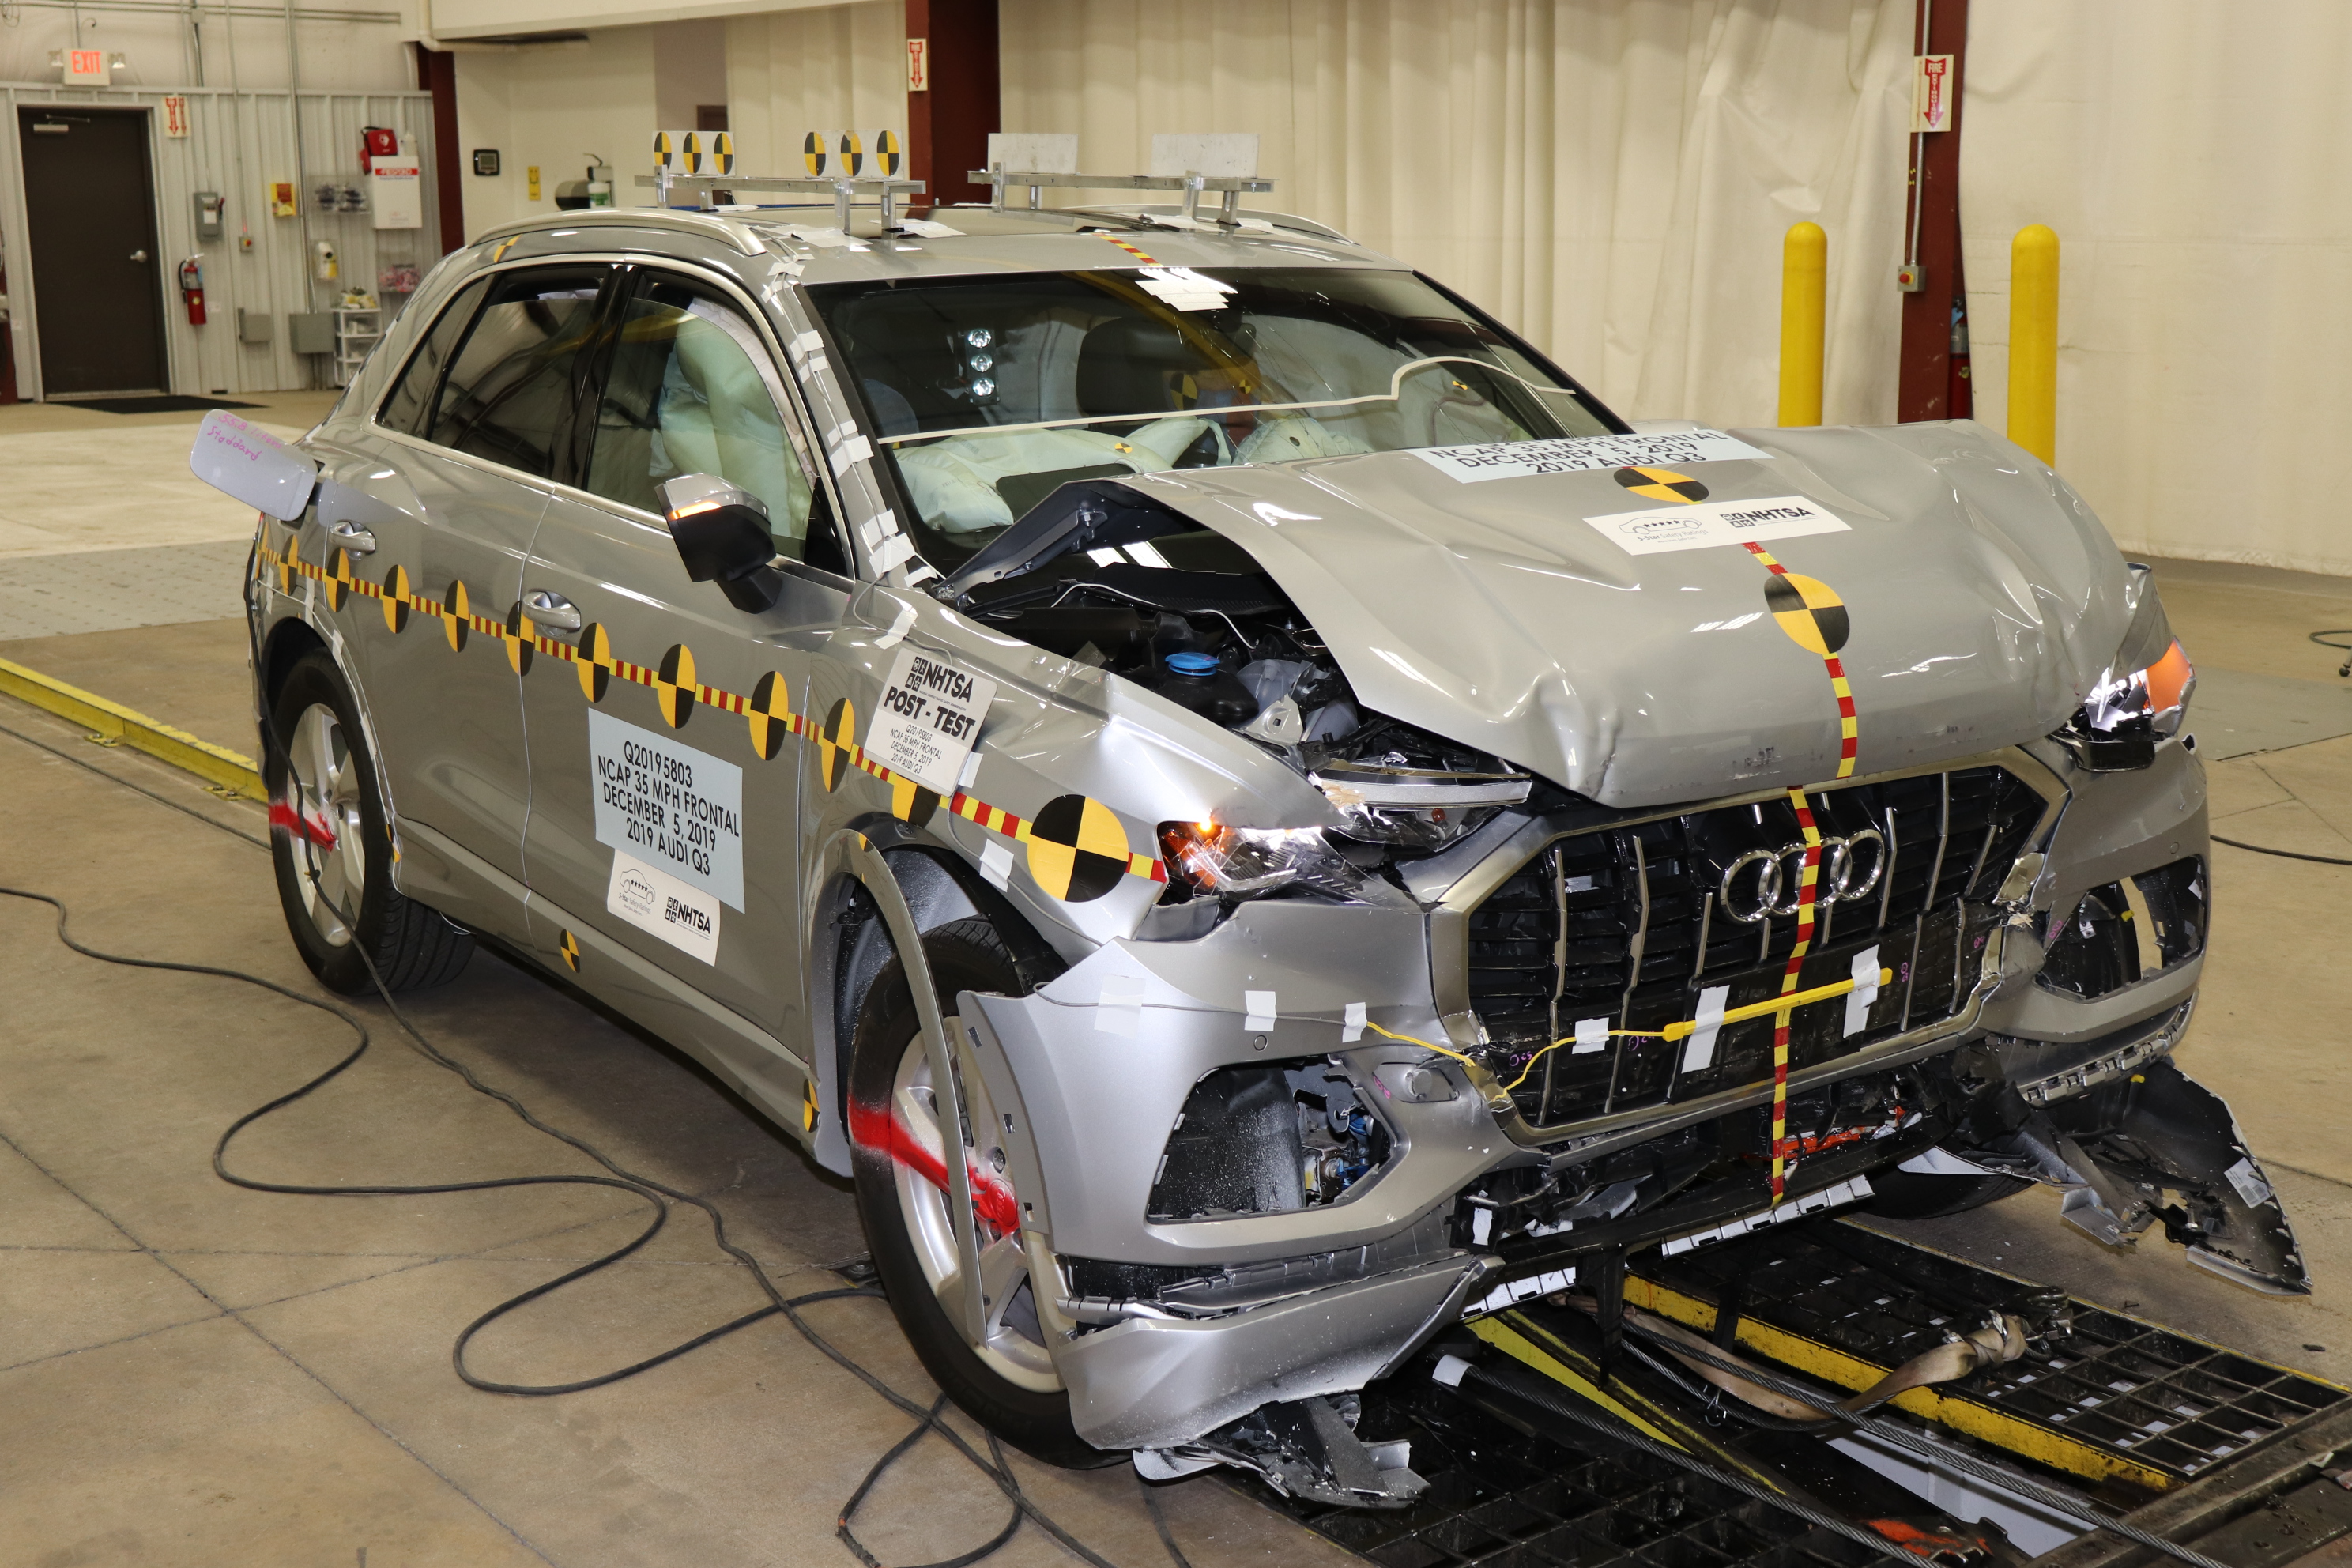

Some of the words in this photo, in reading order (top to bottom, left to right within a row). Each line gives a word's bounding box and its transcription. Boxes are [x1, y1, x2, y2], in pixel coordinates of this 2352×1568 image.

[71, 51, 101, 74] EXIT
[1928, 62, 1943, 73] FIRE
[1428, 446, 1506, 458] NCAP
[1550, 440, 1615, 450] MPH
[1615, 432, 1728, 446] FRONTAL
[1455, 449, 1602, 468] DECEMBER
[1637, 442, 1698, 454] 2019
[1526, 460, 1589, 473] 2019
[1597, 455, 1666, 467] AUDI
[1664, 452, 1707, 462] Q3
[1742, 507, 1816, 522] NHTSA
[922, 662, 974, 703] NHTSA
[884, 686, 927, 720] POST
[933, 705, 976, 741] TEST
[890, 728, 904, 740] NCAP
[903, 734, 910, 744] 35
[908, 737, 921, 748] MPH
[919, 742, 942, 760] FRONTAL
[906, 724, 933, 742] Q20195803
[624, 741, 692, 788] Q20195803
[891, 741, 914, 758] DECEMBER
[918, 754, 932, 767] 2019
[891, 752, 903, 764] 2019
[901, 758, 914, 770] AUDI
[913, 763, 922, 774] Q3
[598, 755, 631, 787] NCAP
[635, 770, 649, 796] 35
[653, 778, 680, 810] MPH
[684, 791, 739, 838] FRONTAL
[603, 782, 665, 829] DECEMBER
[673, 812, 684, 840] 5,
[687, 820, 716, 852] 2019
[627, 817, 654, 848] 2019
[658, 832, 688, 865] AUDI
[692, 848, 710, 876] Q3
[677, 902, 711, 934] NHTSA
